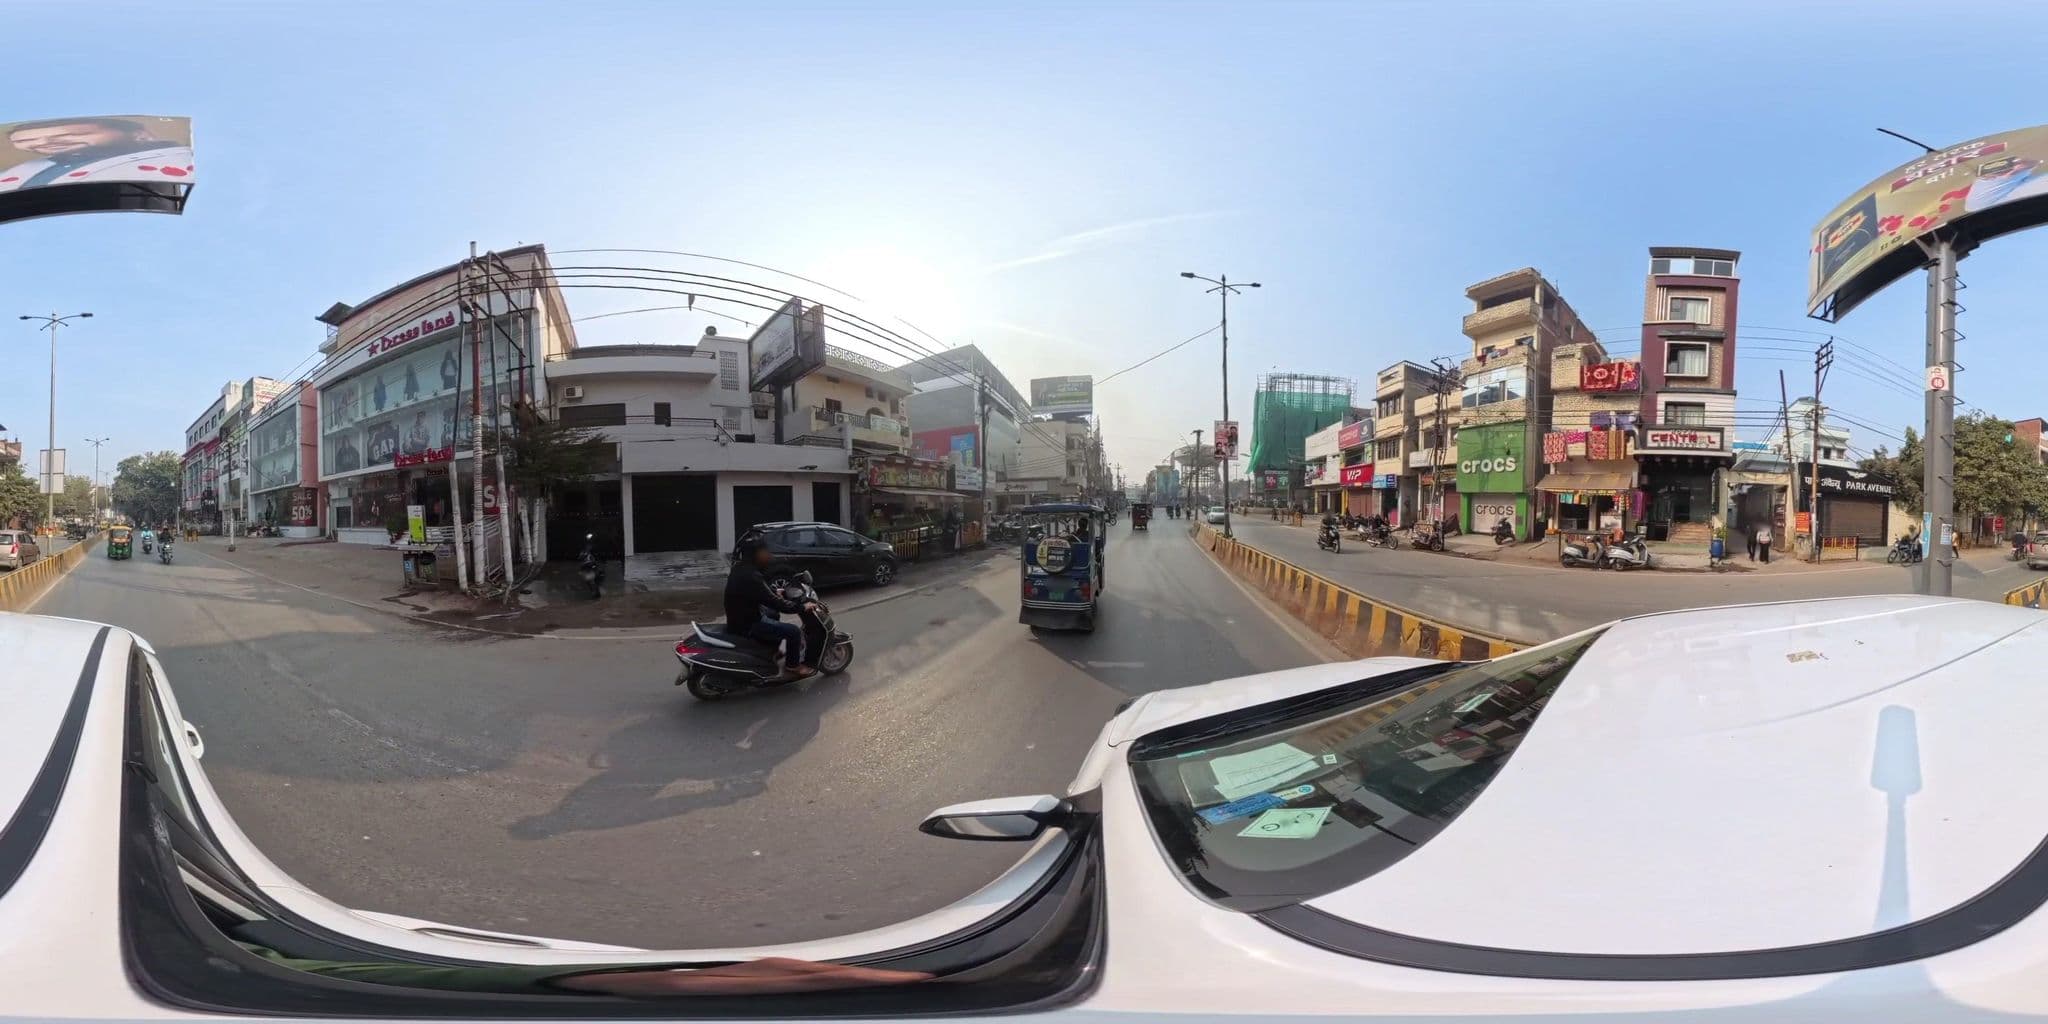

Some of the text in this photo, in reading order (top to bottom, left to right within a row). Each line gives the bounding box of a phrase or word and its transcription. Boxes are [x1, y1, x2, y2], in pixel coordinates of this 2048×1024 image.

[381, 326, 420, 352] Dress
[373, 439, 395, 460] GAP
[1461, 457, 1516, 474] crocs
[1347, 469, 1362, 481] VIP
[1846, 480, 1892, 494] PARK AVENUE
[1476, 504, 1514, 516] crocs
